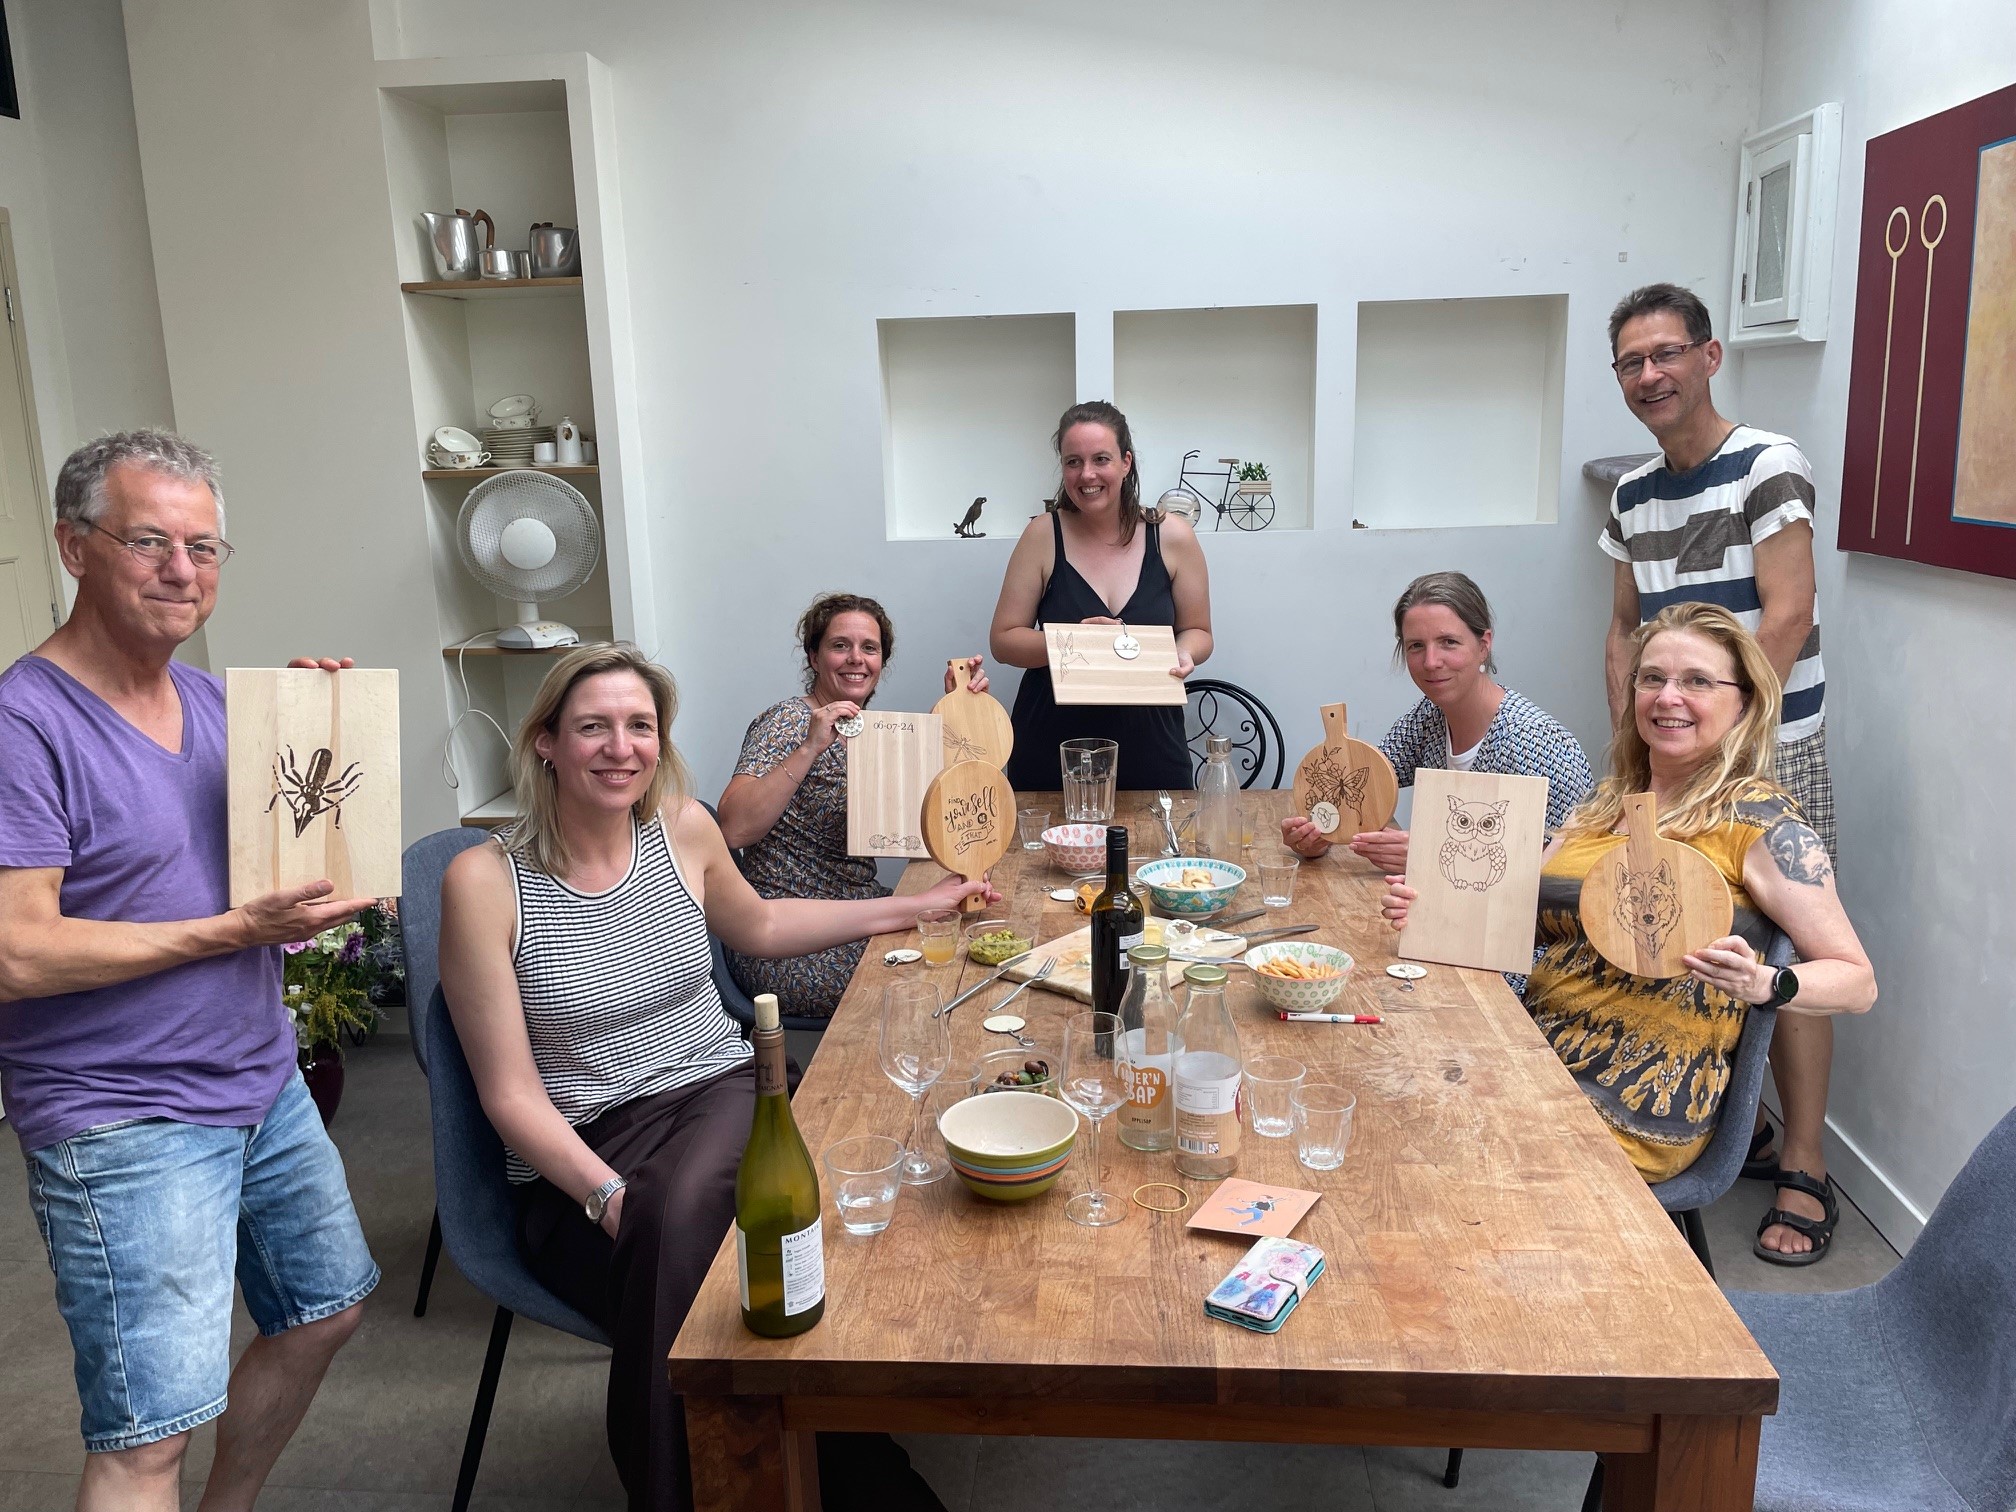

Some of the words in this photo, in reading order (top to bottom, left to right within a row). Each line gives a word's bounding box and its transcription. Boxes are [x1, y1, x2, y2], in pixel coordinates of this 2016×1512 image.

[873, 720, 914, 733] 06-07-24
[945, 785, 998, 833] yourself
[957, 819, 973, 832] AND
[966, 831, 982, 840] THAT
